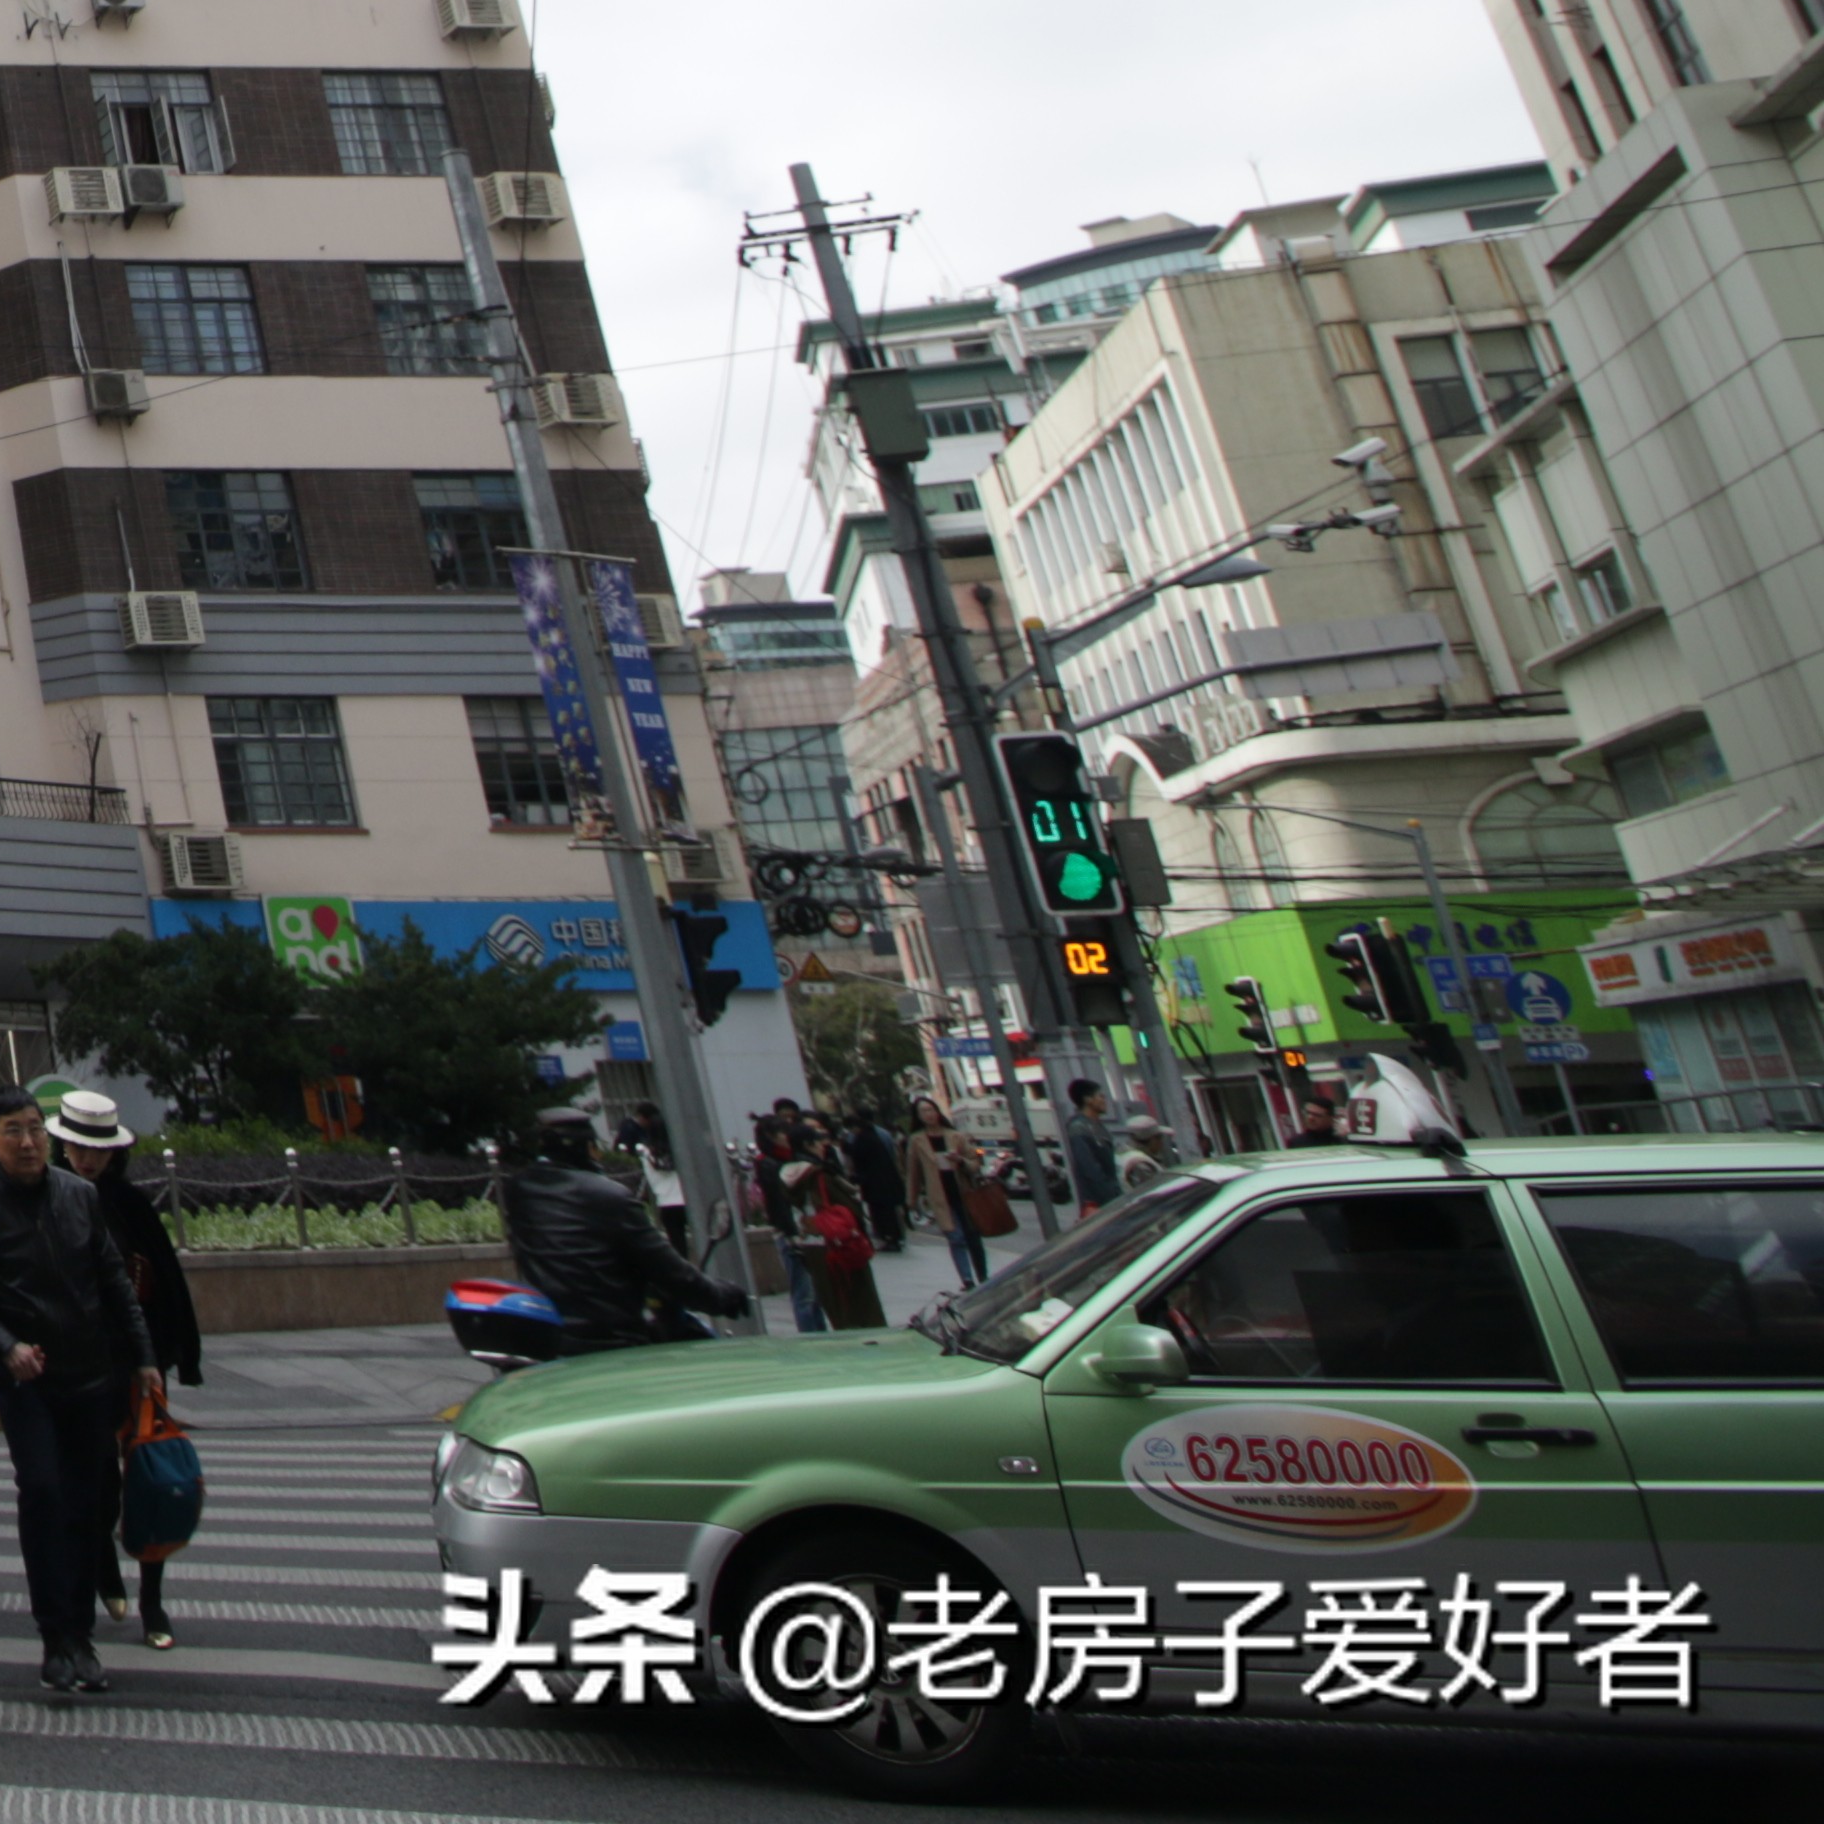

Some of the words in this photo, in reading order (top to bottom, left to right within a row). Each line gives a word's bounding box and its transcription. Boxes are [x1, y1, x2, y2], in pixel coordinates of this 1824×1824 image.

[611, 642, 650, 661] HAPPY
[627, 678, 654, 694] NEW
[632, 712, 665, 728] YEAR
[1032, 800, 1088, 842] 01
[1065, 943, 1109, 974] 02
[1185, 1434, 1434, 1490] 62580000
[1231, 1493, 1399, 1511] www.62580000.com
